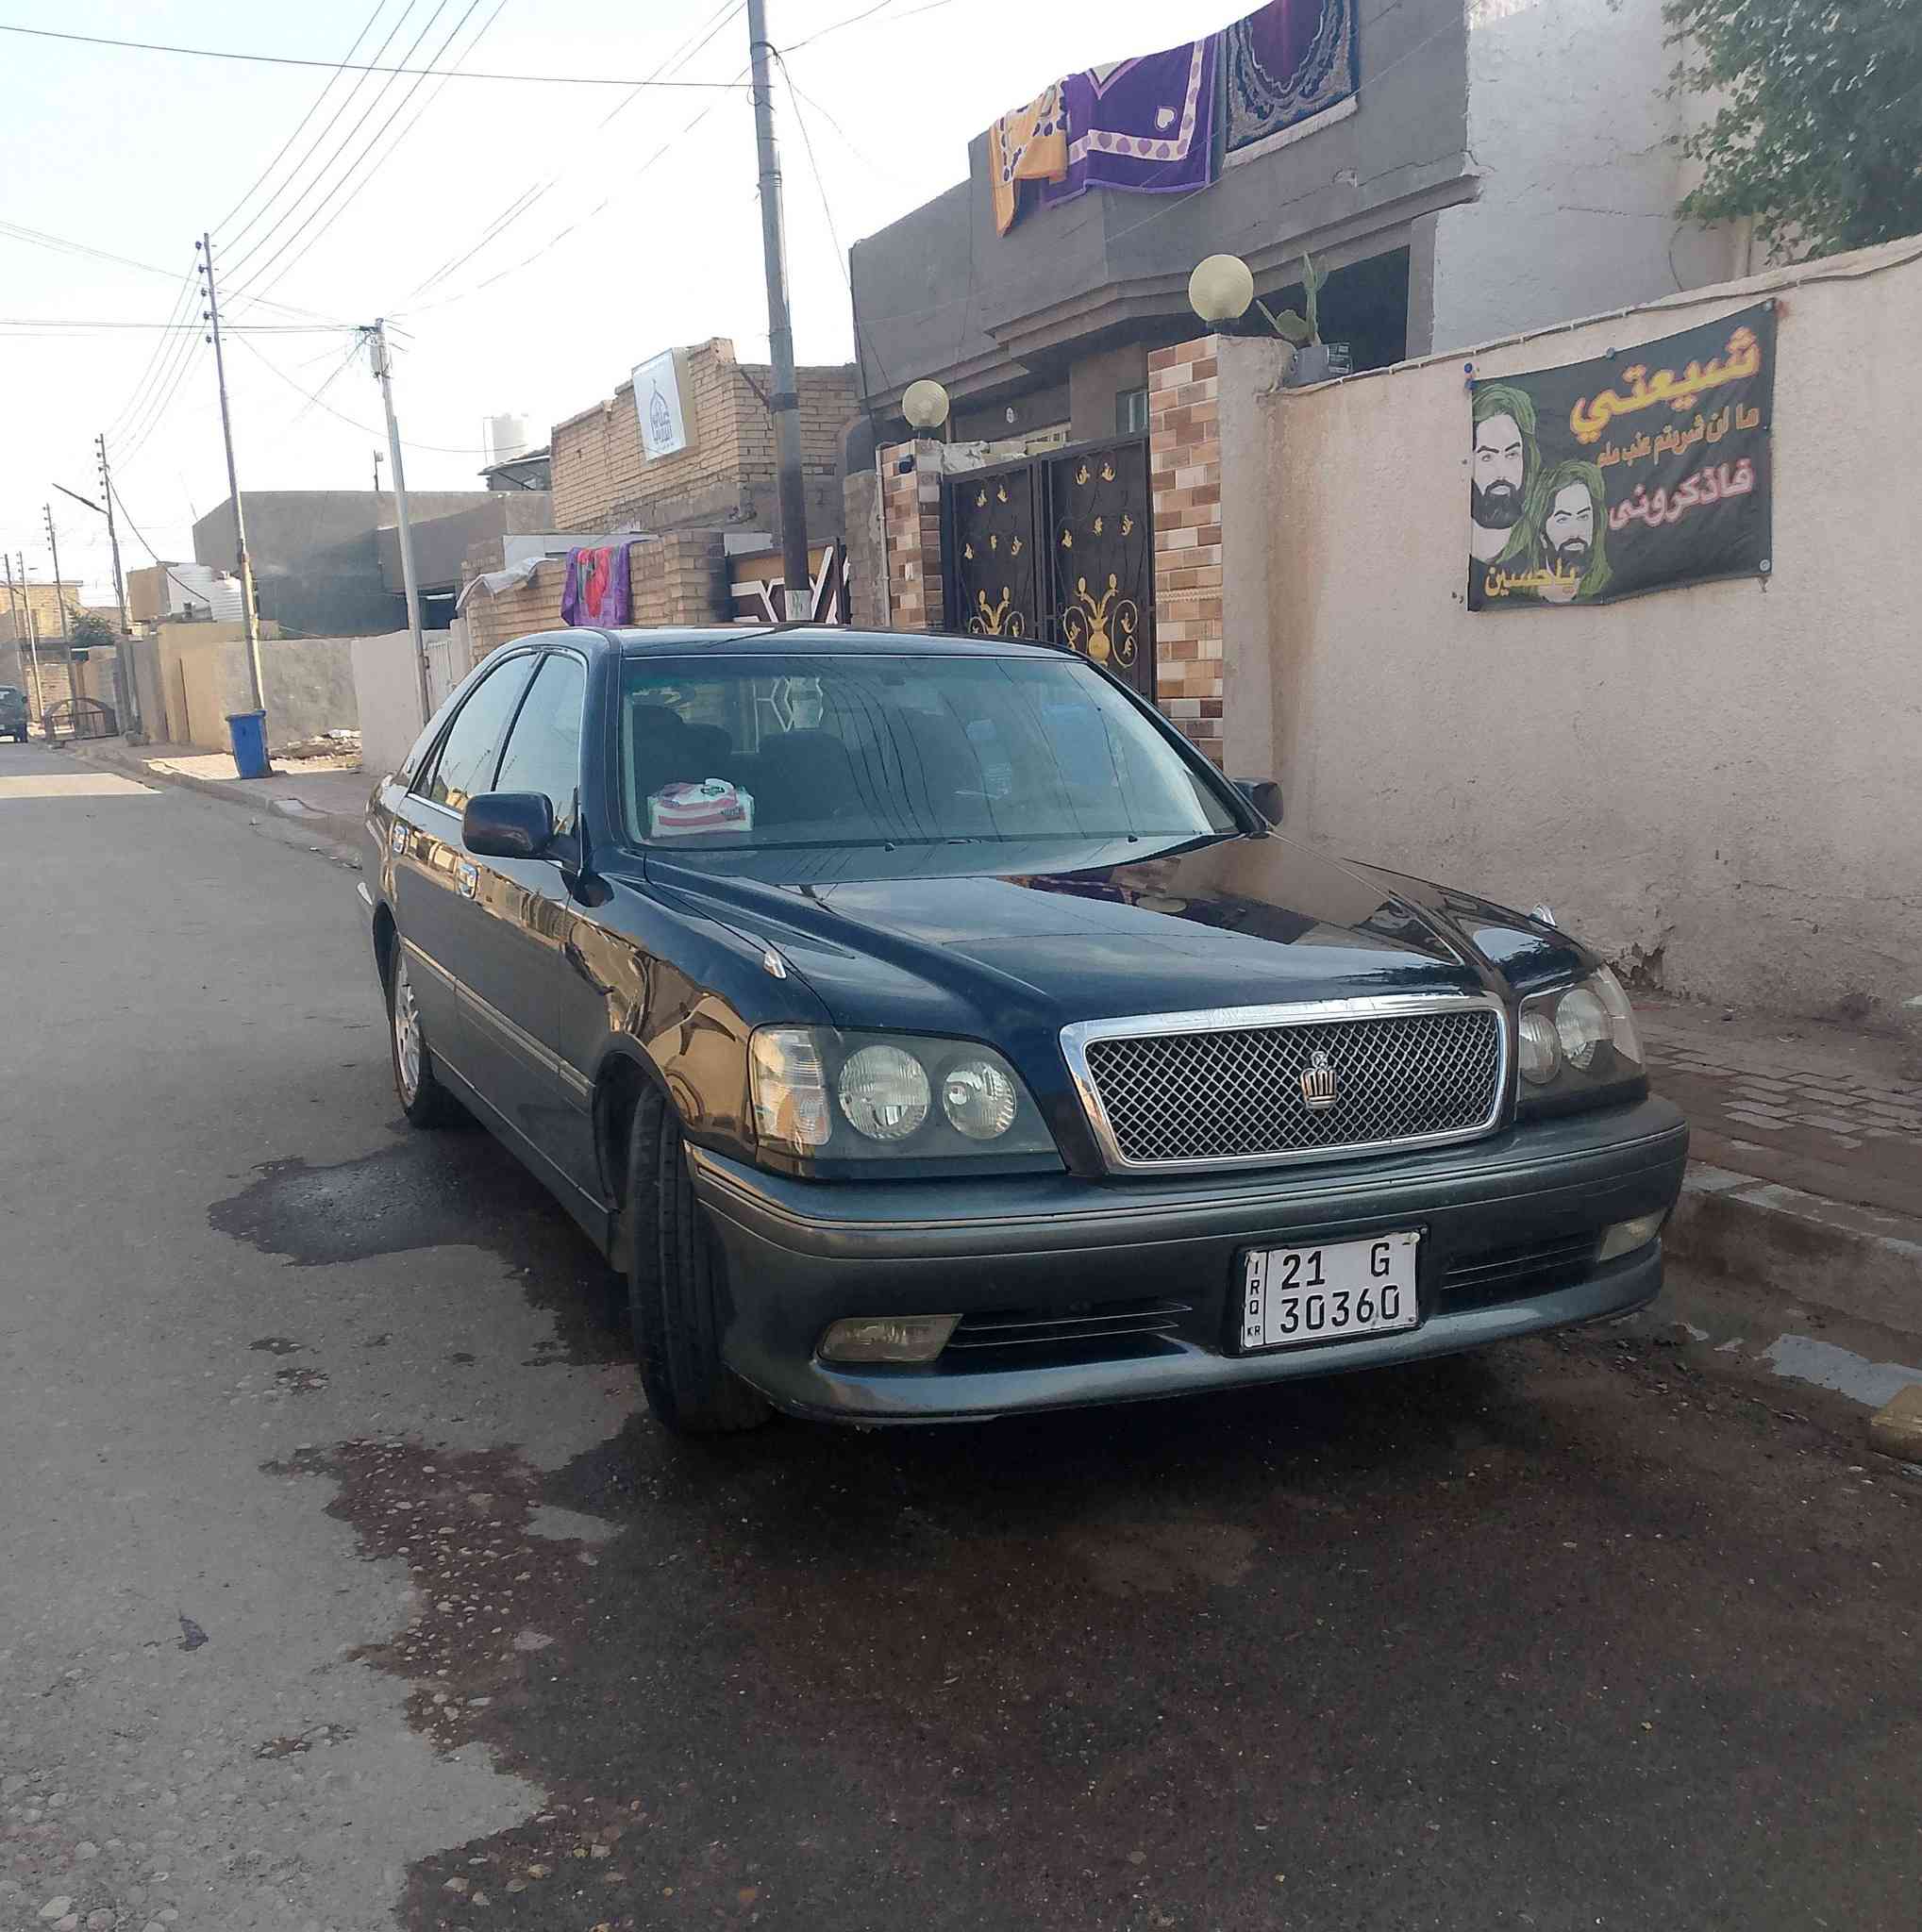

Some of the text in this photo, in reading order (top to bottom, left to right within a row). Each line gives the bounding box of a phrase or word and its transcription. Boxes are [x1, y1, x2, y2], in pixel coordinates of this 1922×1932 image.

[1570, 326, 1763, 445] شيعتي
[1281, 1241, 1390, 1291] 21 G
[1246, 1324, 1262, 1337] KR
[1279, 1284, 1400, 1334] 30360
